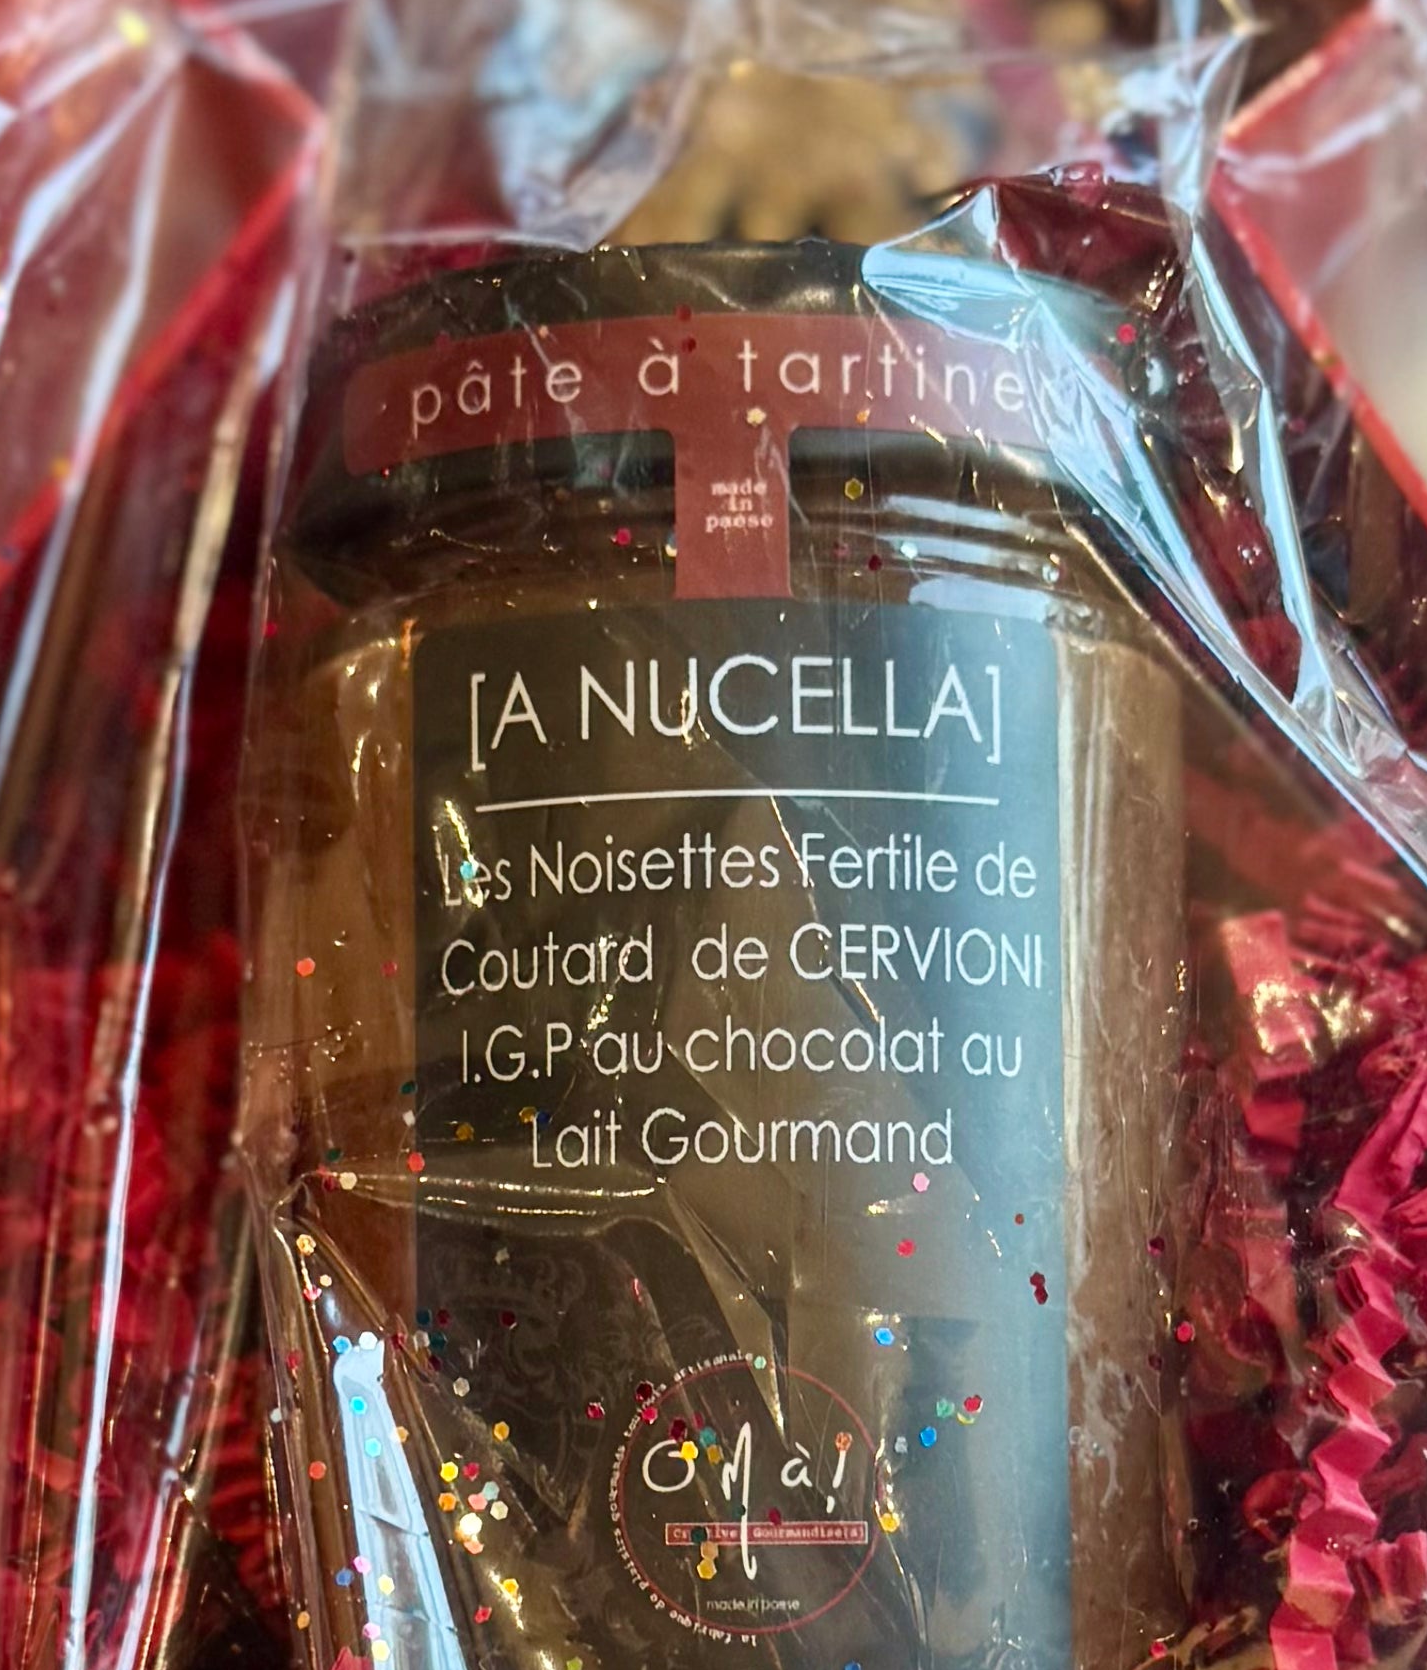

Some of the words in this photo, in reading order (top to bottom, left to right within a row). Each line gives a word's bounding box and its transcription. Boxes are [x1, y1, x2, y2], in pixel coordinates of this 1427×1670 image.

[413, 356, 582, 440] pâte
[638, 336, 679, 396] à
[710, 478, 768, 496] made
[580, 655, 1002, 765] NUCELLA]
[444, 853, 512, 906] Les
[530, 833, 780, 898] Noisettes
[800, 832, 958, 892] Fertile
[975, 841, 1037, 900] de
[441, 923, 654, 996] Coutard
[691, 922, 769, 980] de
[789, 922, 1043, 990] CERVIONI
[592, 1027, 664, 1076] au
[685, 1015, 945, 1074] chocolat
[962, 1031, 1022, 1078] au
[531, 1109, 621, 1168] Lait
[641, 1107, 954, 1167] Gourmand
